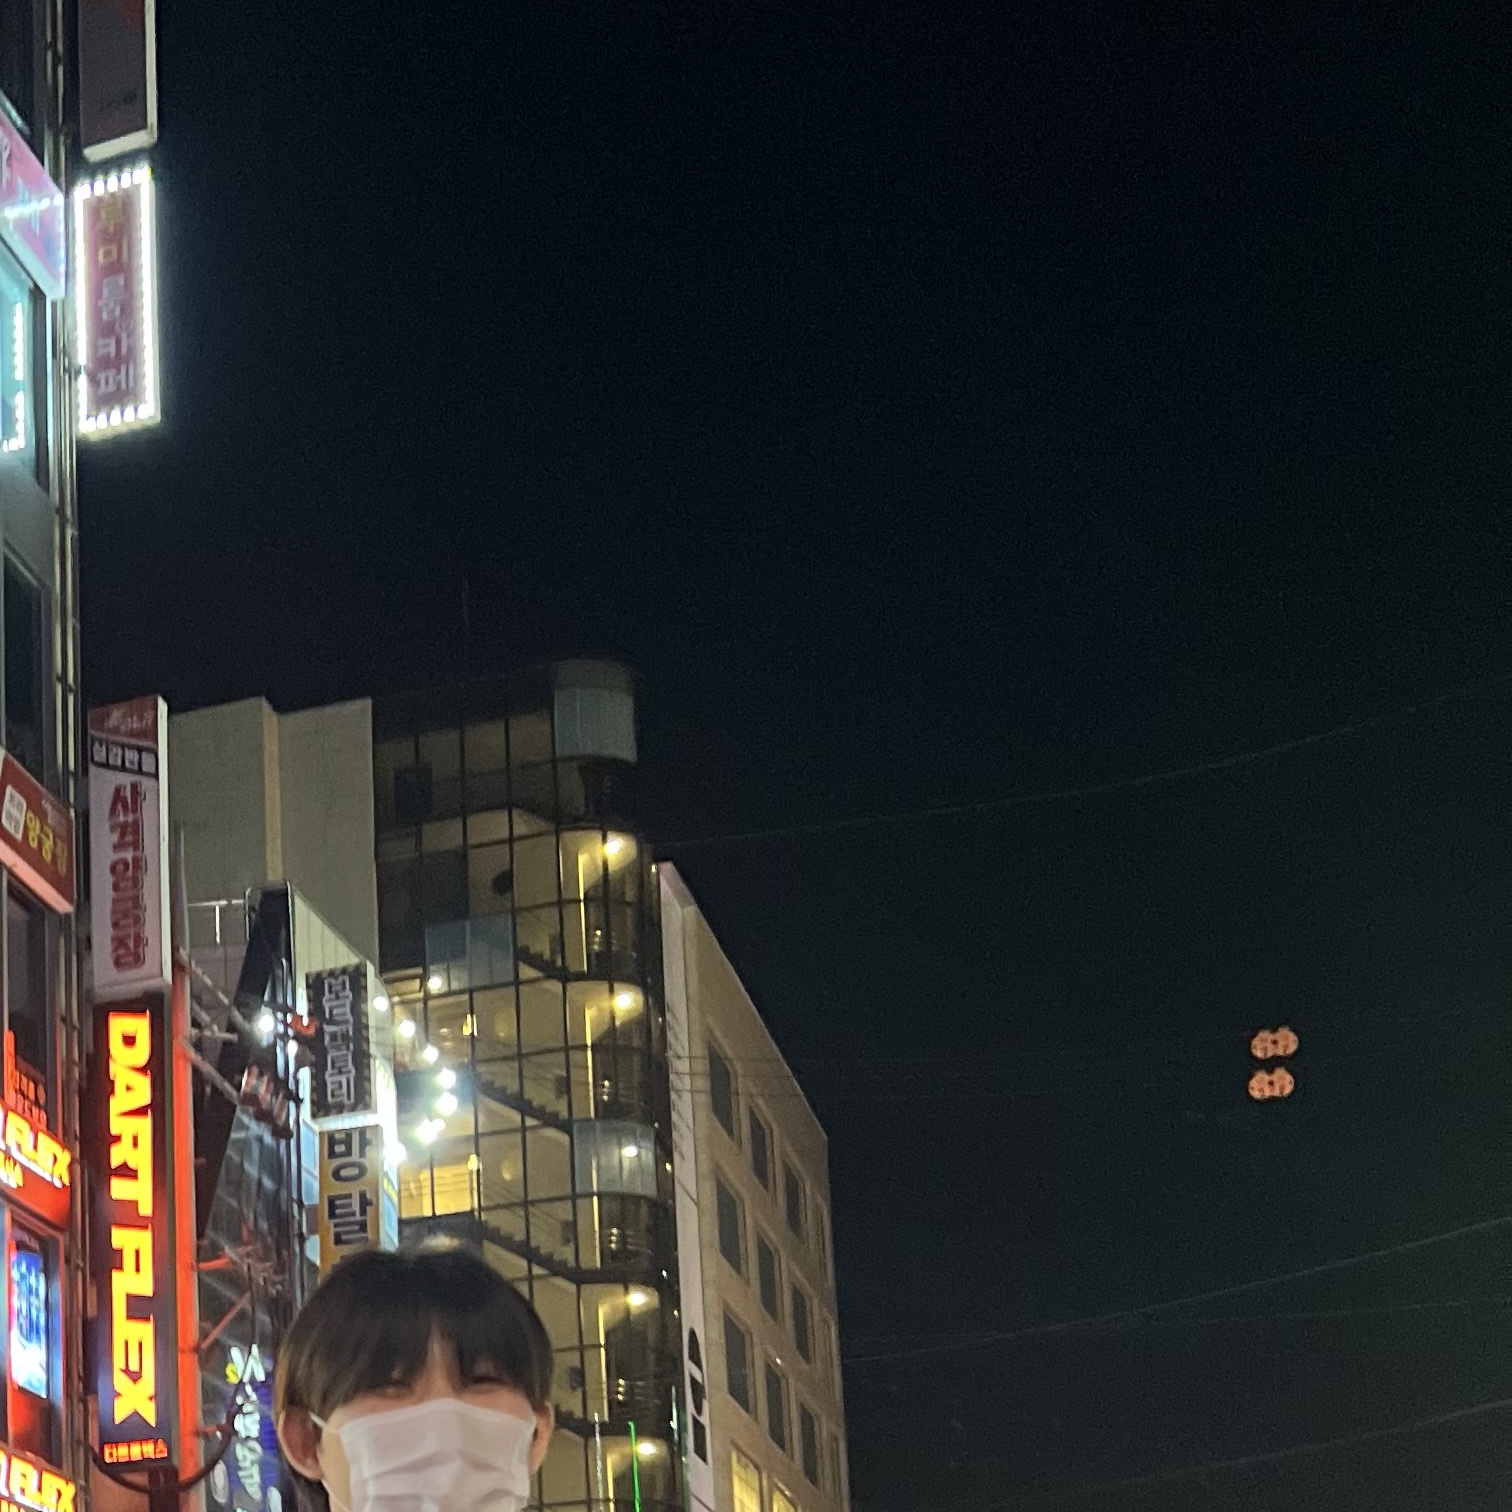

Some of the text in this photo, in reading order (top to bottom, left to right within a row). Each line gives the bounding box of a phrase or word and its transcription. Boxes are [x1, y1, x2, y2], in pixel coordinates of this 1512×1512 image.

[5, 1110, 72, 1189] FLEX
[108, 1008, 158, 1429] DART FLEX
